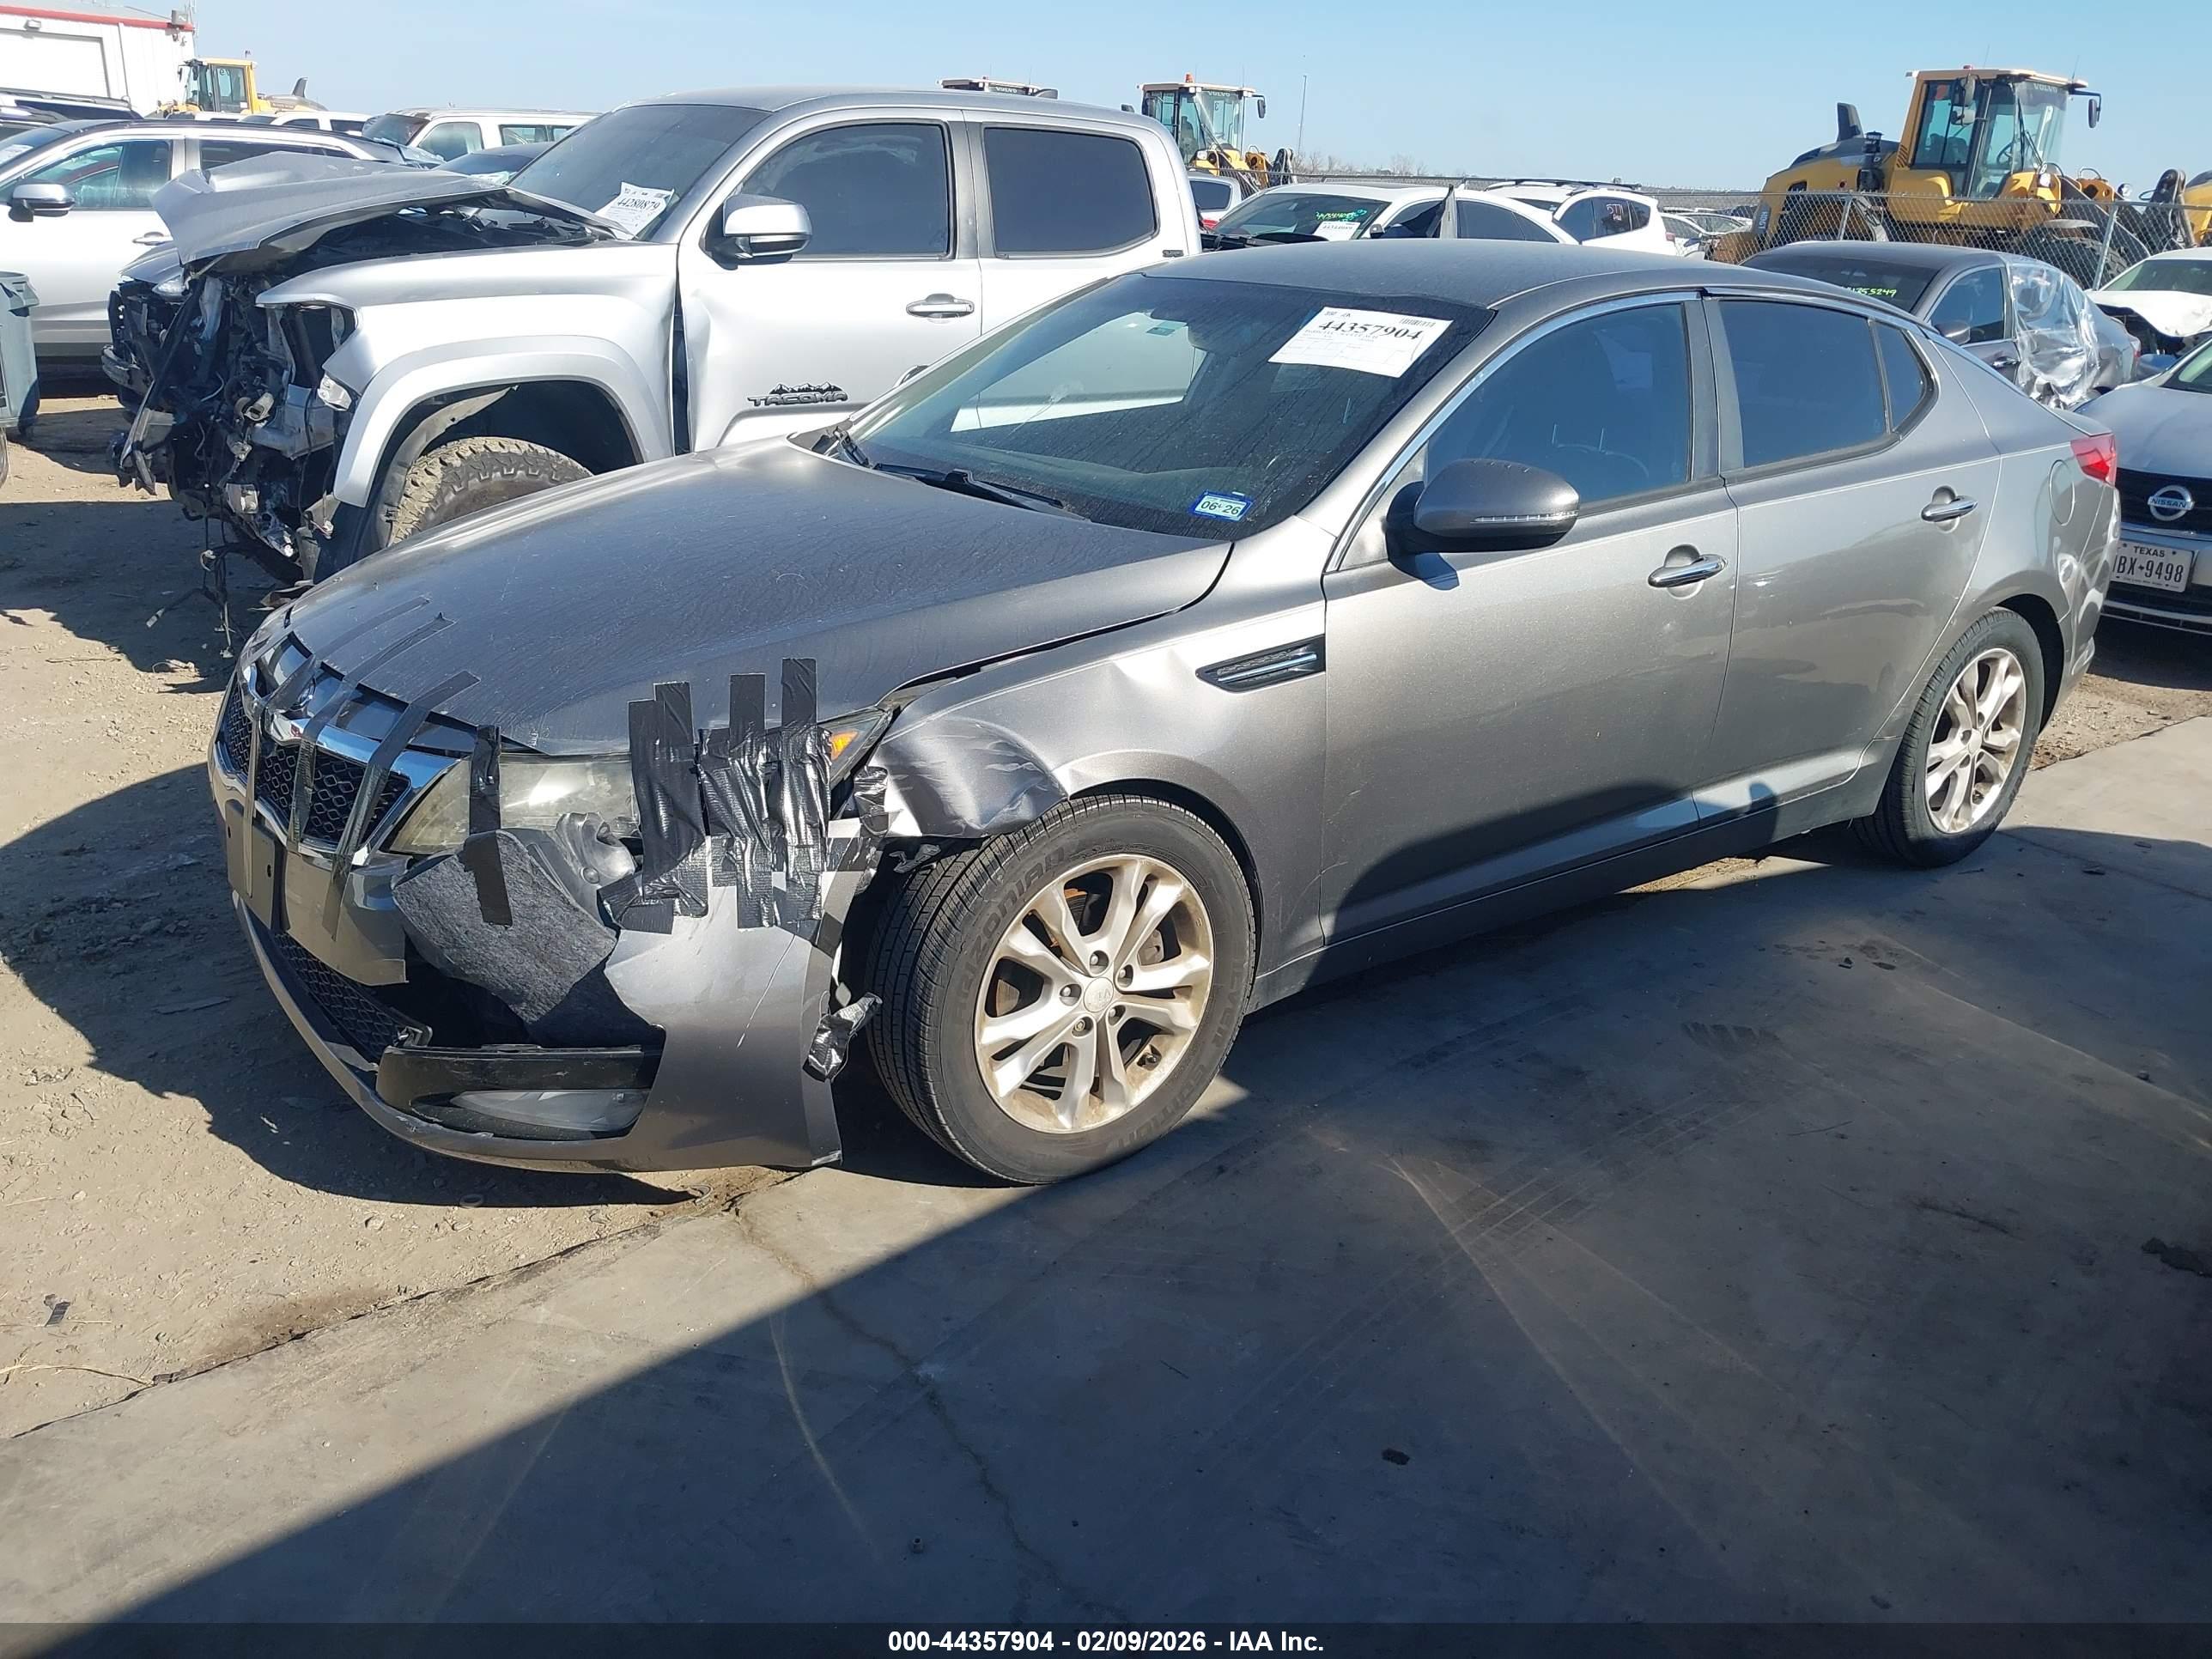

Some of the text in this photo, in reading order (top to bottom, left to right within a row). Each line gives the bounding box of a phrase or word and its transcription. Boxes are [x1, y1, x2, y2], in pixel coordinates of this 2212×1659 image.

[2033, 83, 2057, 93] VOLVO
[617, 198, 660, 211] 44280879
[1319, 320, 1423, 340] 44357904
[747, 392, 848, 407] TACOMA
[1200, 501, 1242, 515] 06 26
[2151, 497, 2186, 508] NISSAN
[2134, 546, 2166, 558] TEXAS
